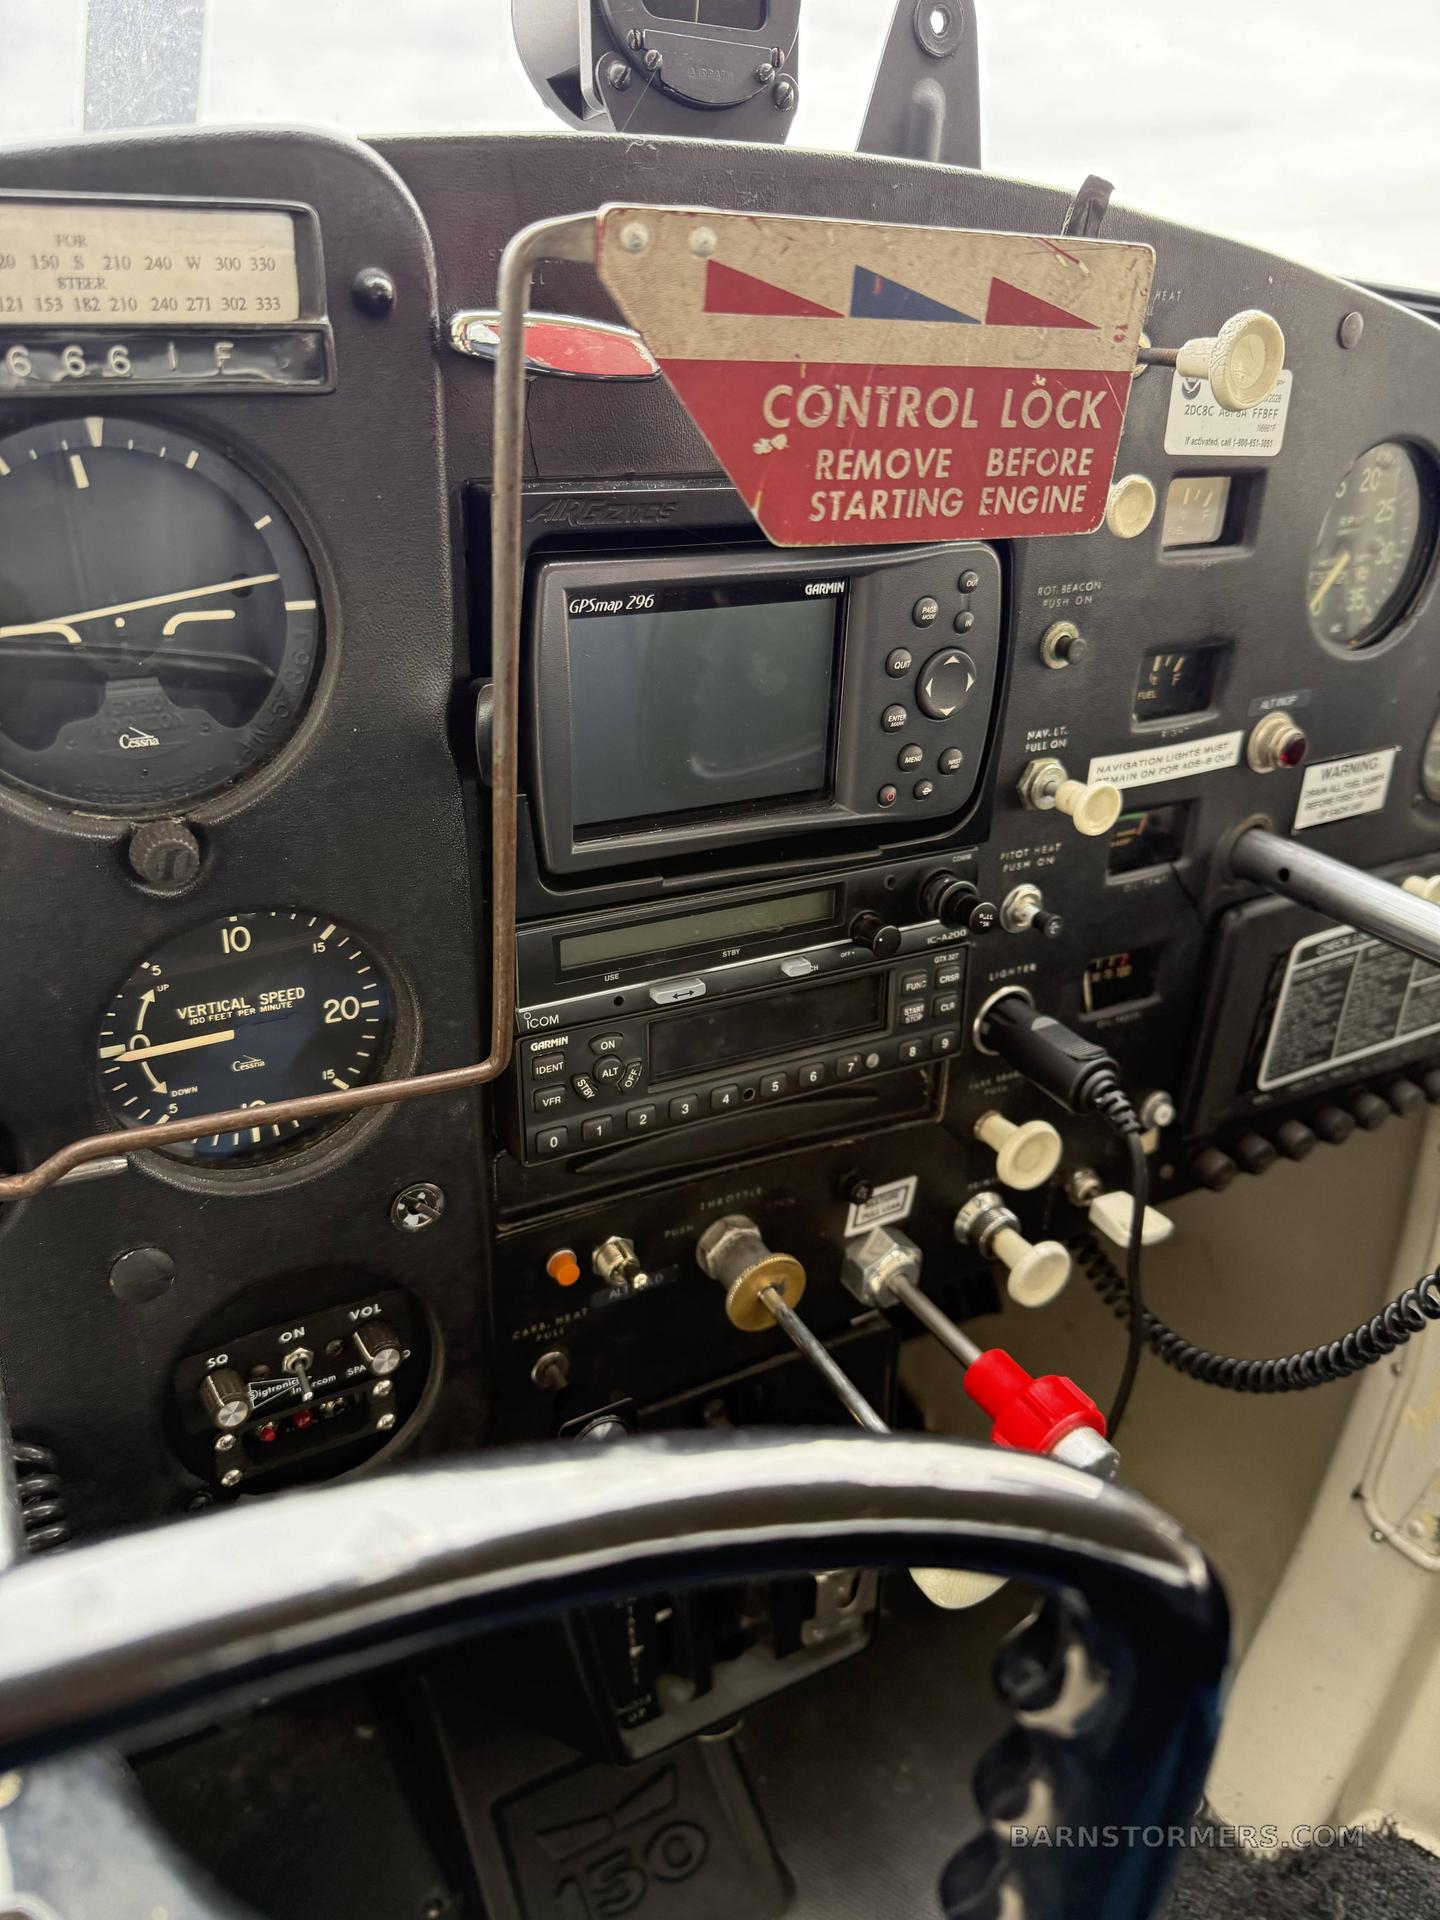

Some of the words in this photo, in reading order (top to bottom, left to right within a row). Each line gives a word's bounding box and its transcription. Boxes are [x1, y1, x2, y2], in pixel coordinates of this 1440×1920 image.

[55, 234, 88, 248] FOR
[0, 256, 15, 270] 20
[31, 256, 59, 271] 150
[103, 256, 131, 271] 210
[144, 256, 172, 271] 240
[186, 257, 201, 271] W
[215, 257, 242, 272] 300
[250, 257, 276, 272] 330
[57, 277, 107, 290] STEER
[1153, 290, 1182, 303] HEAT
[35, 297, 63, 312] 153
[74, 297, 101, 312] 182
[110, 297, 138, 312] 210
[151, 297, 178, 312] 240
[186, 297, 212, 312] 271
[222, 297, 248, 312] 302
[255, 297, 281, 312] 333
[763, 384, 978, 429] CONTROL
[1000, 388, 1107, 430] LOCK
[1184, 404, 1215, 417] 2DC8C
[1184, 436, 1190, 445] If
[1191, 437, 1220, 448] activated,
[1220, 438, 1232, 447] call
[815, 448, 952, 481] REMOVE
[985, 447, 1095, 478] BEFORE
[1360, 467, 1382, 491] 20
[809, 488, 963, 523] STARTING
[979, 484, 1087, 516] ENGINE
[1374, 498, 1396, 523] 25
[804, 581, 845, 596] GARMIN
[966, 578, 979, 588] OUT
[1061, 581, 1102, 594] BEACON
[569, 598, 623, 614] GPSmap
[625, 593, 655, 610] 296
[1043, 598, 1069, 608] PUSH
[1075, 595, 1093, 606] ON
[922, 605, 937, 614] PAGE
[965, 619, 972, 627] IN
[894, 660, 911, 670] QUIT
[1137, 690, 1157, 700] FUEL
[888, 714, 907, 722] ENTER
[119, 731, 159, 749] Cessna
[1025, 741, 1047, 752] PULL
[1050, 738, 1067, 749] ON
[904, 754, 922, 764] MENU
[1096, 755, 1164, 775] NAVIGATION
[1165, 748, 1201, 763] LIGHTS
[1203, 741, 1230, 753] MUST
[1094, 773, 1138, 784] MAIN
[1140, 768, 1156, 779] ON
[1158, 765, 1180, 775] FOR
[1214, 751, 1234, 764] OUT
[1321, 757, 1378, 781] WARNING
[1000, 848, 1029, 860] PITOT
[1034, 842, 1062, 854] HEAT
[1003, 861, 1030, 873] PUSH
[1037, 856, 1056, 867] ON
[222, 926, 251, 954] 10
[927, 929, 967, 945] IC-A200
[312, 942, 326, 954] 15
[722, 948, 741, 959] STBY
[840, 950, 853, 959] OFF
[934, 954, 947, 963] GTX
[948, 953, 960, 962] 327
[151, 965, 162, 977] 5
[604, 972, 620, 982] USE
[989, 962, 1037, 982] LIGHTER
[939, 973, 960, 984] CRSR
[157, 983, 170, 992] UP
[906, 980, 927, 992] FUNC
[177, 997, 250, 1020] VERTICAL
[259, 987, 306, 1006] SPEED
[323, 996, 360, 1024] 20
[904, 1004, 925, 1016] START
[940, 1002, 955, 1012] CLR
[189, 1015, 206, 1026] 100
[208, 1012, 233, 1023] FEET
[238, 1007, 257, 1018] PER
[260, 1001, 293, 1013] MINUTE
[905, 1013, 923, 1024] STOP
[530, 1036, 569, 1052] GARMIN
[600, 1039, 616, 1050] ON
[941, 1038, 949, 1050] 9
[908, 1046, 917, 1058] 8
[232, 1057, 266, 1073] Cessna
[536, 1061, 563, 1076] IDENT
[602, 1066, 618, 1078] ALT
[847, 1061, 855, 1073] 7
[322, 1069, 335, 1080] 15
[623, 1067, 638, 1089] OFF
[809, 1071, 818, 1083] 6
[171, 1086, 198, 1098] DOWN
[576, 1077, 595, 1101] STBY
[771, 1080, 780, 1093] 5
[542, 1095, 562, 1107] VFR
[722, 1093, 730, 1105] 4
[169, 1103, 178, 1115] 5
[681, 1103, 690, 1116] 3
[639, 1113, 649, 1127] 2
[596, 1125, 603, 1138] 1
[550, 1135, 559, 1149] 0
[700, 1186, 764, 1211] THROTTLE
[664, 1223, 695, 1240] PUSH
[350, 1303, 382, 1322] VOL
[512, 1320, 552, 1342] CARB.
[555, 1307, 589, 1328] HEAT
[278, 1326, 306, 1344] ON
[536, 1327, 566, 1343] PULL
[206, 1353, 229, 1369] SQ
[249, 1377, 302, 1401] Sigtronic
[291, 1374, 337, 1395] Inrcom
[554, 1819, 709, 1920] 150
